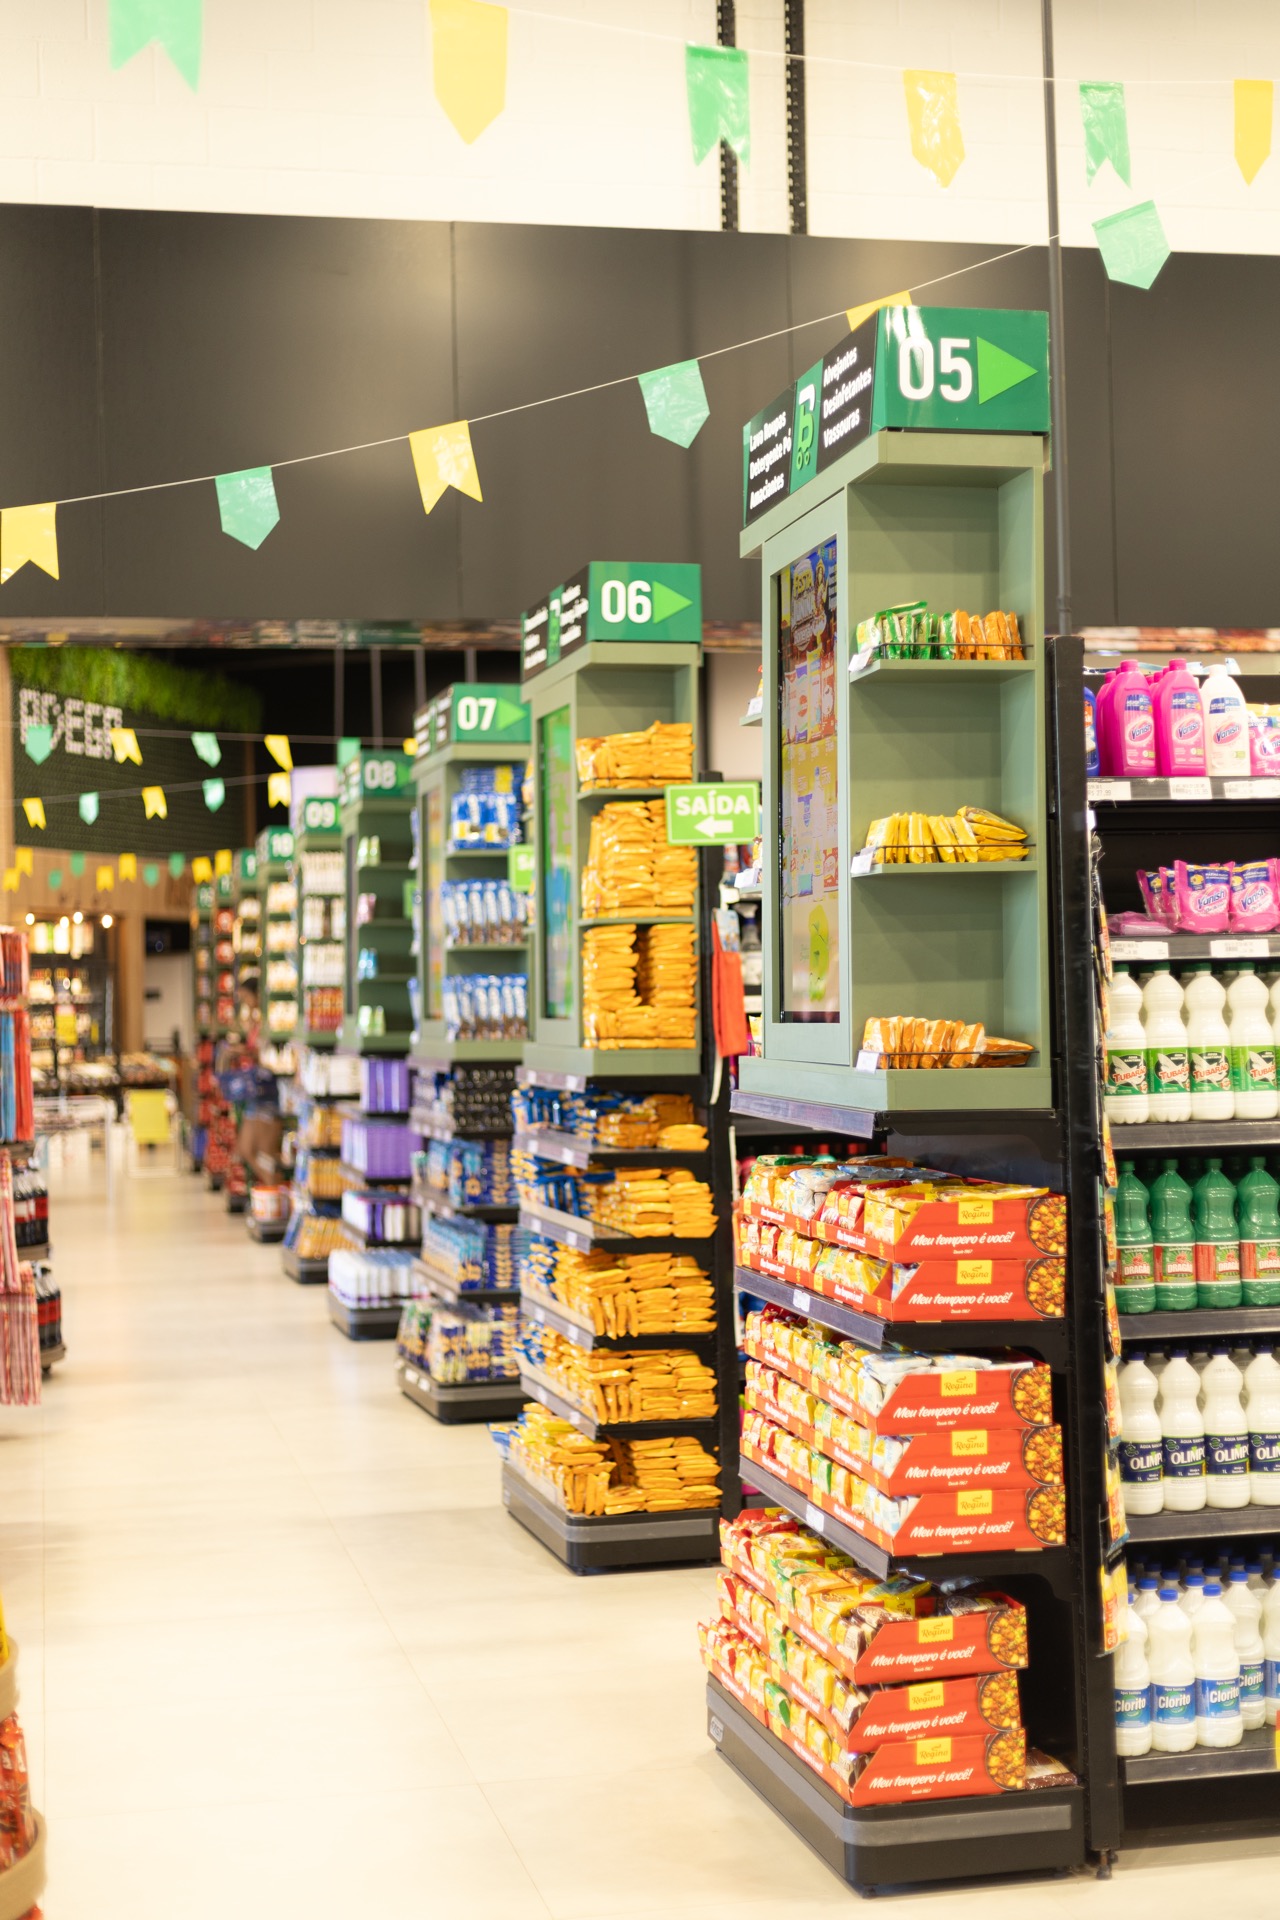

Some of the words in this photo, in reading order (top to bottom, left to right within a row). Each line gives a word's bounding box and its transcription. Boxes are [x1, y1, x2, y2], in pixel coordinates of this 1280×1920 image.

[899, 336, 973, 403] 05
[823, 408, 860, 448] Vassouras
[601, 579, 652, 624] 06
[457, 696, 498, 731] 07
[1131, 723, 1153, 740] Vanish
[1178, 720, 1201, 738] Vanish
[1216, 724, 1241, 742] Vanish
[363, 759, 397, 790] 08
[675, 789, 751, 816] SAÍDA
[305, 801, 337, 828] 09
[1198, 890, 1226, 910] Vanish
[1241, 887, 1267, 910] Vanish
[961, 1209, 990, 1219] Regina
[910, 1234, 935, 1246] Meu
[935, 1233, 978, 1247] tempero
[979, 1232, 987, 1244] é
[986, 1231, 1016, 1243] você!
[960, 1269, 989, 1279] Regina
[908, 1293, 933, 1305] Meu
[933, 1293, 976, 1307] tempero
[976, 1292, 985, 1304] é
[984, 1292, 1014, 1304] você!
[943, 1381, 974, 1391] Regina
[893, 1407, 917, 1419] Meu
[918, 1406, 961, 1419] tempero
[962, 1403, 971, 1415] é
[970, 1402, 999, 1414] você!
[954, 1441, 985, 1451] Regina
[1130, 1451, 1163, 1470] OLIMP
[905, 1466, 929, 1479] Meu
[930, 1465, 973, 1479] tempero
[974, 1463, 982, 1475] é
[981, 1461, 1010, 1474] você!
[960, 1500, 989, 1510] Regina
[910, 1526, 934, 1538] Meu
[935, 1525, 977, 1539] tempero
[978, 1522, 986, 1534] é
[985, 1521, 1015, 1534] você!
[922, 1629, 951, 1638] Regina
[871, 1655, 895, 1667] Meu
[896, 1653, 939, 1666] tempero
[939, 1649, 948, 1661] é
[947, 1646, 976, 1659] você!
[912, 1694, 941, 1704] Regina
[1115, 1697, 1146, 1712] Clorito
[1158, 1694, 1191, 1709] Clorito
[863, 1724, 887, 1737] Meu
[888, 1719, 930, 1733] tempero
[931, 1715, 940, 1727] é
[939, 1711, 967, 1723] você!
[919, 1750, 949, 1759] Regina
[869, 1777, 893, 1789] Meu
[894, 1774, 937, 1788] tempero
[938, 1771, 946, 1783] é
[945, 1768, 974, 1780] você!
